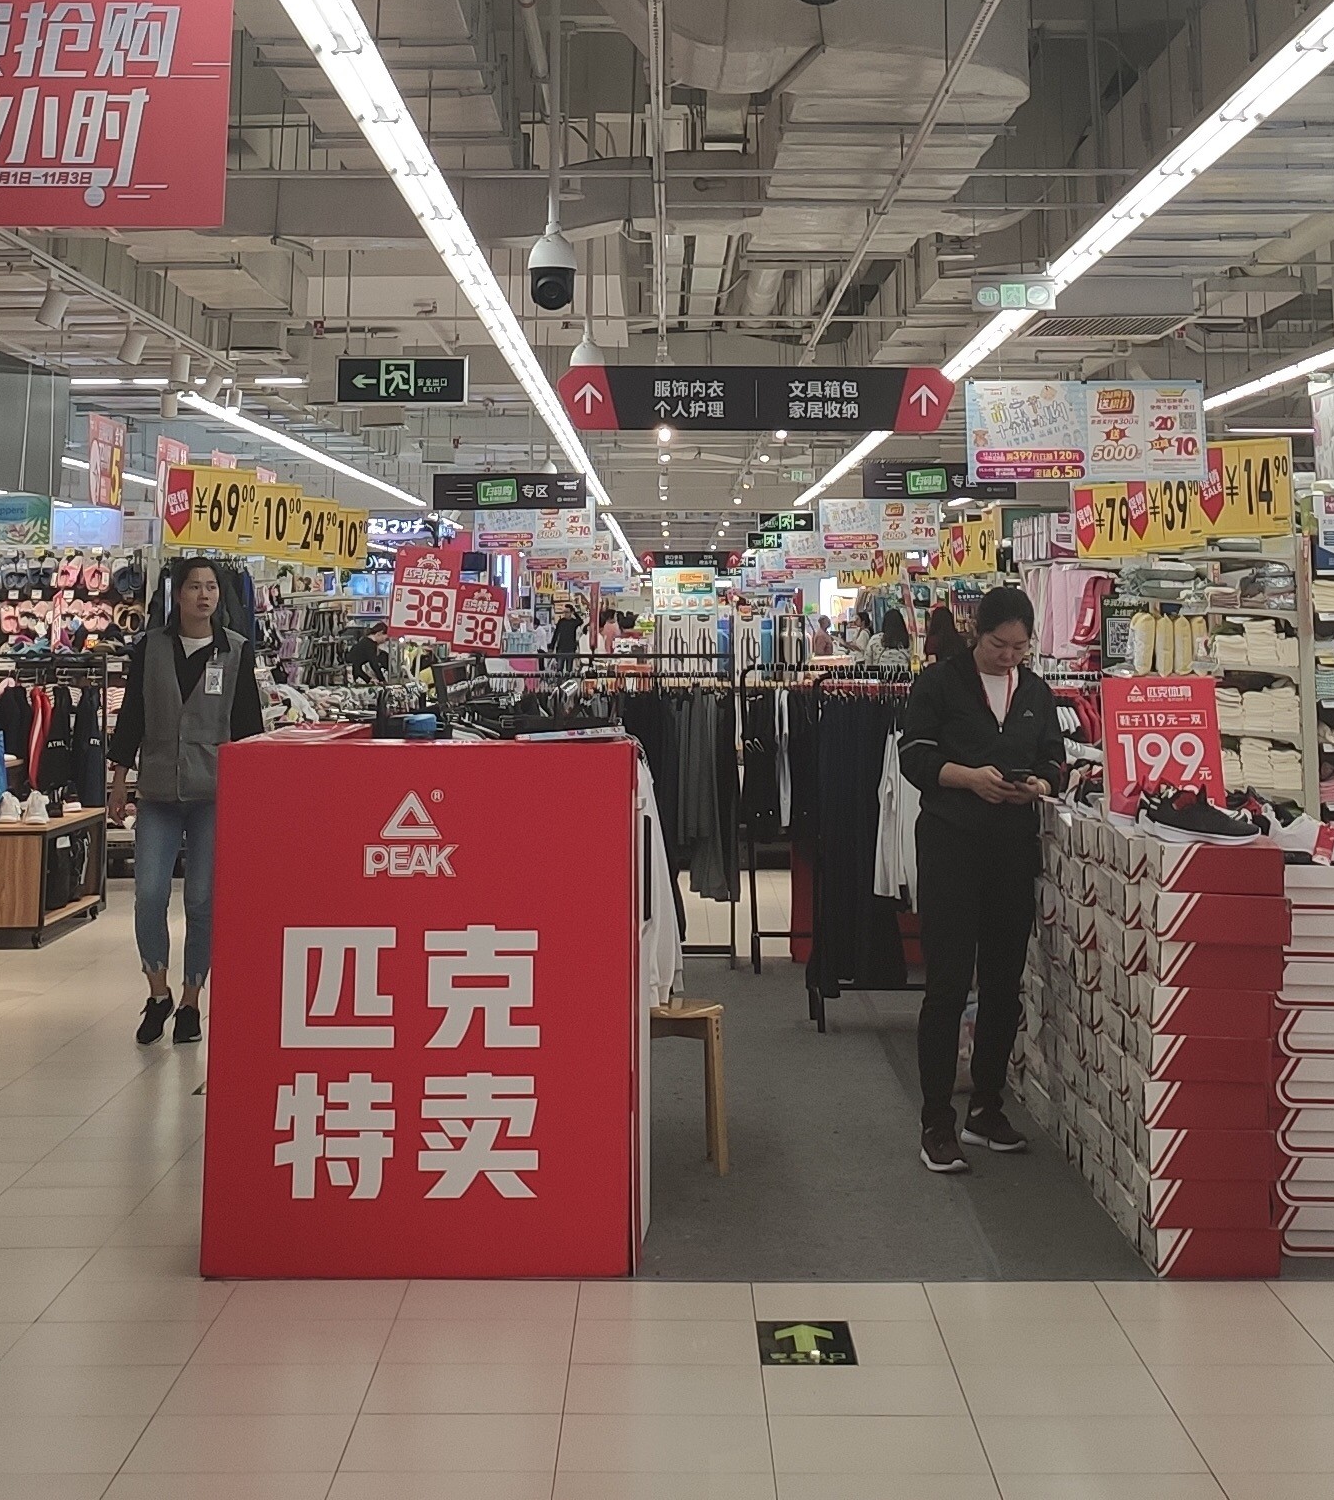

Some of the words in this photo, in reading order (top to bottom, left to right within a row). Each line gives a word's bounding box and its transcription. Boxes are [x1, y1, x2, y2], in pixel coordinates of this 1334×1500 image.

[422, 386, 442, 394] EXIT
[654, 380, 725, 398] 服饰内衣
[788, 380, 859, 398] 文具箱包
[654, 400, 725, 419] 个人护理
[788, 401, 860, 419] 家居收纳
[521, 484, 548, 498] 专区
[1202, 485, 1223, 501] SALE
[170, 503, 190, 516] SALE
[1078, 514, 1095, 530] SALE
[1119, 713, 1202, 727] 鞋子119元一双
[1118, 732, 1212, 782] 199元
[363, 844, 459, 878] PEAK
[280, 924, 541, 1049] 匹克
[273, 1072, 538, 1200] 特卖
